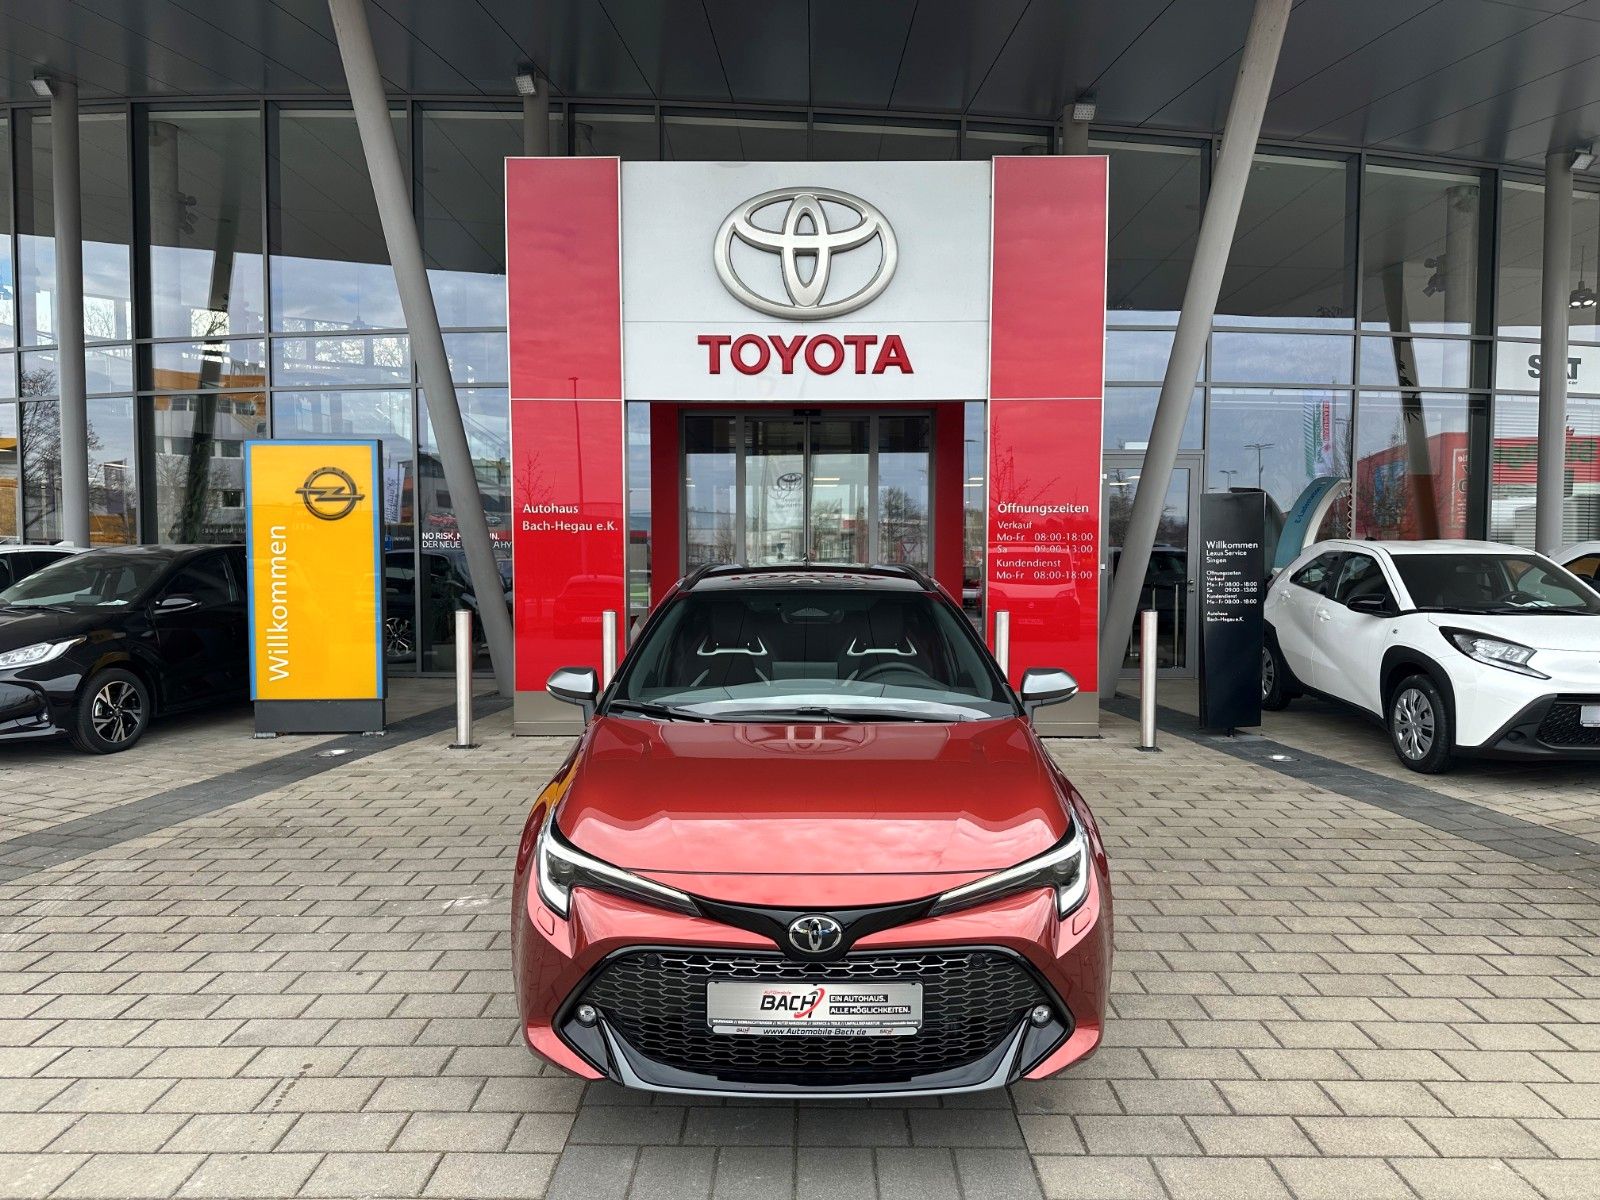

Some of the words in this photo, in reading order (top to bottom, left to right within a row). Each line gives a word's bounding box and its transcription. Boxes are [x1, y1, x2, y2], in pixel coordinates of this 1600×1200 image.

[697, 333, 914, 376] TOYOTA
[1528, 354, 1581, 379] ST
[522, 503, 579, 514] Autohaus
[997, 502, 1089, 516] Öffnungszeiten
[522, 520, 593, 534] Bach-Hegau
[596, 521, 618, 531] e.K.
[997, 520, 1033, 530] Verkauf
[422, 532, 434, 540] NO
[435, 532, 456, 541] RISK,
[996, 533, 1025, 541] Mo-Fr
[1034, 532, 1094, 541] 08:00-18:00
[422, 540, 438, 549] DER
[439, 540, 461, 549] NEUE
[997, 545, 1008, 553] Sa
[1034, 544, 1093, 553] 09:00-13:00
[1206, 540, 1259, 549] Willkommen
[996, 559, 1062, 568] Kundendienst
[996, 571, 1025, 580] Mo-Fr
[1033, 570, 1093, 579] 08:00-18:00
[266, 525, 289, 682] Willkommen
[843, 994, 886, 1002] AUTOHAUS.
[760, 993, 817, 1014] BACH
[851, 1005, 911, 1014] MÖGLICHKEITEN.
